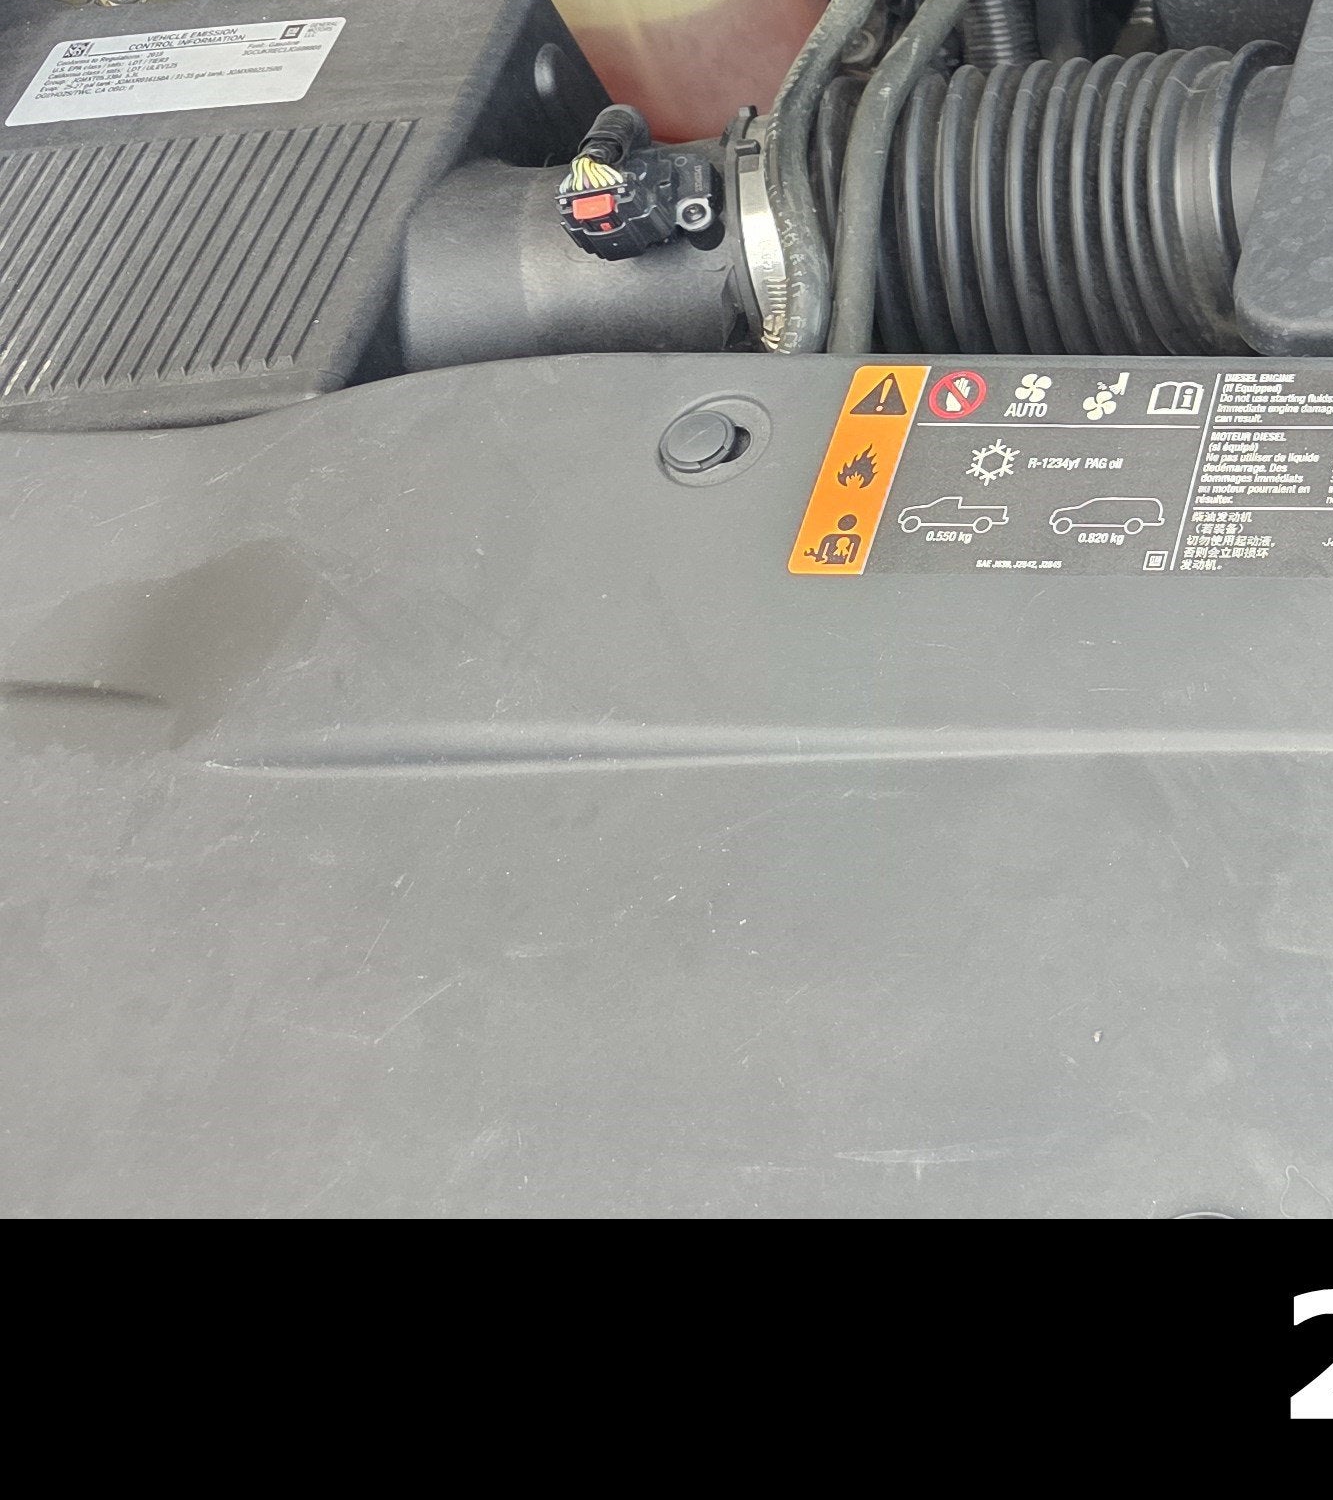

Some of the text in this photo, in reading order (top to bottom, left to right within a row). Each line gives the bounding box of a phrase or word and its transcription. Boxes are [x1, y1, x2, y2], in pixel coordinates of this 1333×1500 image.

[147, 28, 238, 41] VEHICLE EMISSION
[129, 35, 245, 50] CONTROL INFORMATION
[1224, 373, 1296, 383] DIESEL ENGINE
[1222, 383, 1283, 394] (If Equipped)
[1219, 393, 1233, 403] Do
[1234, 394, 1250, 403] not
[1251, 395, 1269, 403] use
[1270, 394, 1307, 405] starting
[1004, 402, 1048, 418] AUTO
[1267, 405, 1300, 414] engine
[1214, 414, 1263, 423] can result.
[1211, 432, 1287, 441] MOTEUR DIESEL
[1208, 442, 1222, 452] (si
[1205, 453, 1320, 463] Ne pas utiliser de liquide
[1027, 457, 1123, 470] R-1234yf PAG oil
[1269, 463, 1288, 473] Des
[1200, 474, 1304, 484] dommages immédiats
[1197, 485, 1311, 495] au moteur pourraient en
[1194, 494, 1234, 504] résulter.
[1191, 511, 1252, 522] 柴油发动机
[925, 531, 973, 544] 0.550 kg
[1078, 533, 1125, 546] 0.820 kg
[1183, 547, 1270, 559] 否则会立即损坏
